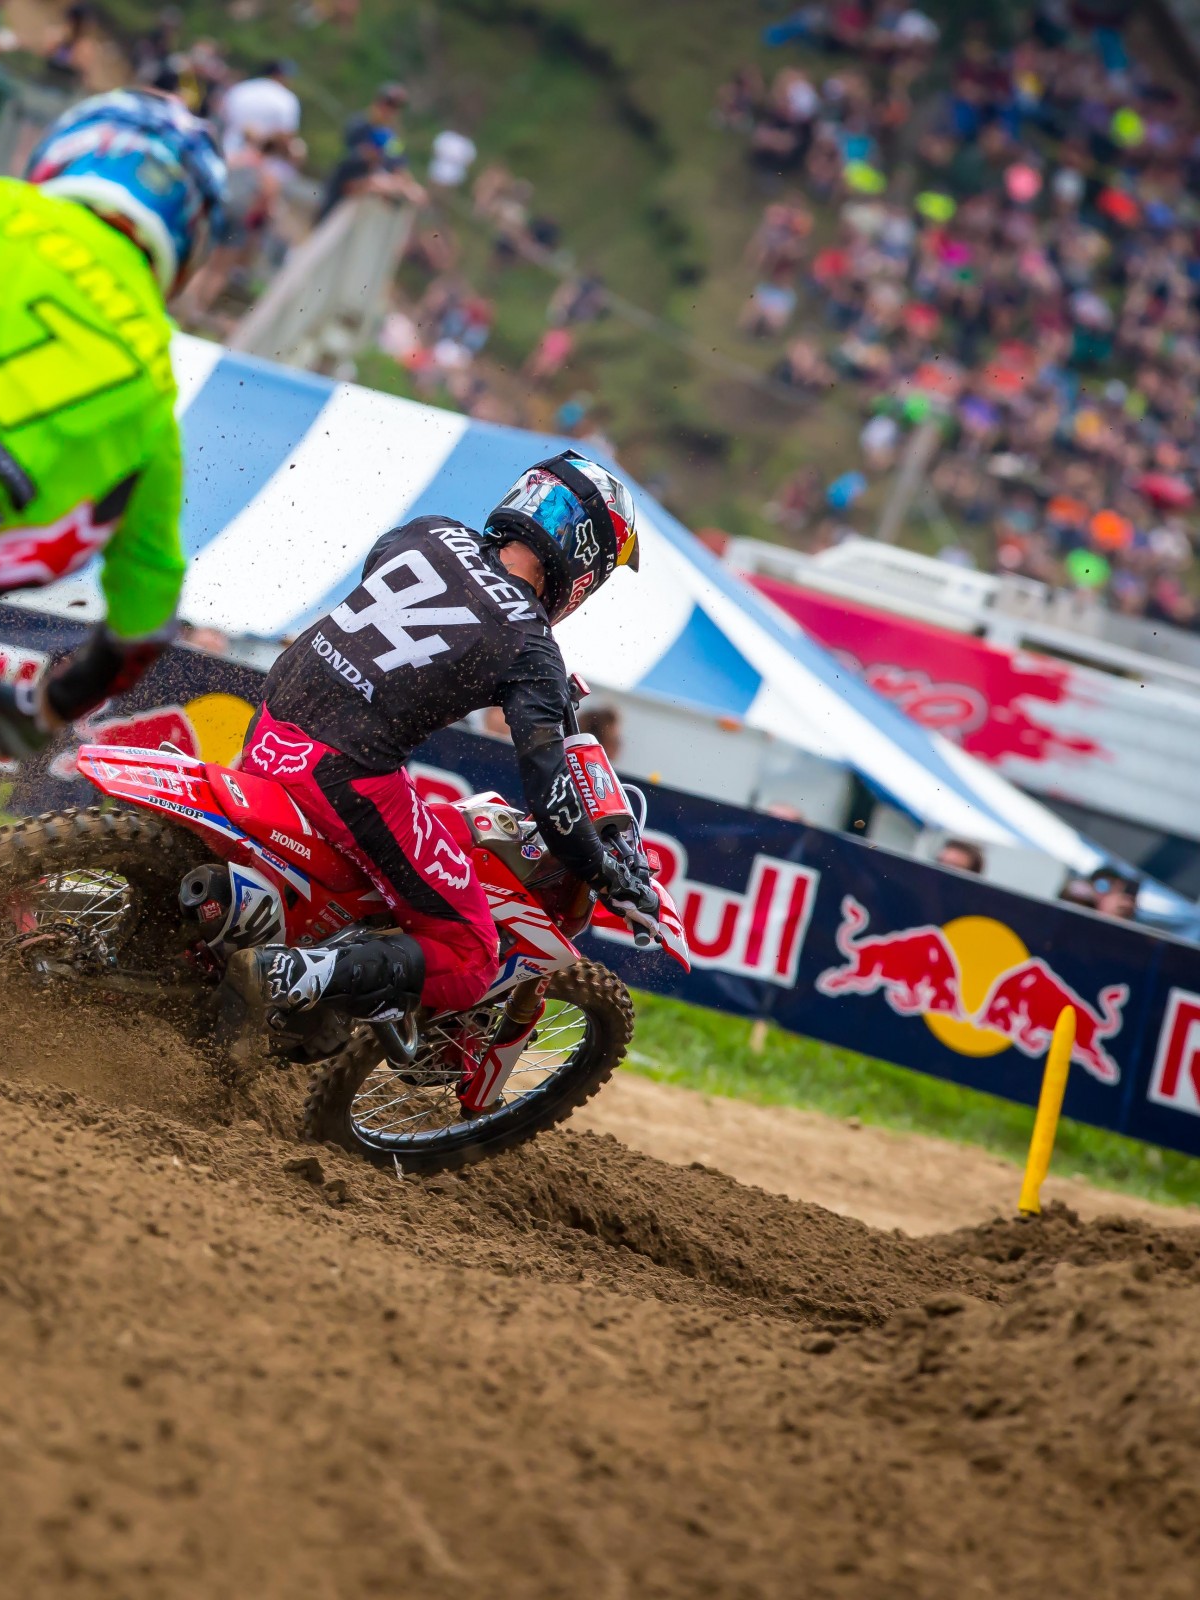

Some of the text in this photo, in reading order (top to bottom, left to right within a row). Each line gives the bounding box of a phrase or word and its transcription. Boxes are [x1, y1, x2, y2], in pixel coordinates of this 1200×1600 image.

[429, 527, 537, 622] ROCZEN
[329, 550, 481, 673] 94
[311, 631, 375, 703] HONDA
[148, 796, 204, 820] DUNLOP
[566, 753, 600, 817] RENTHAL
[270, 829, 311, 860] HONDA
[517, 959, 549, 976] HRC
